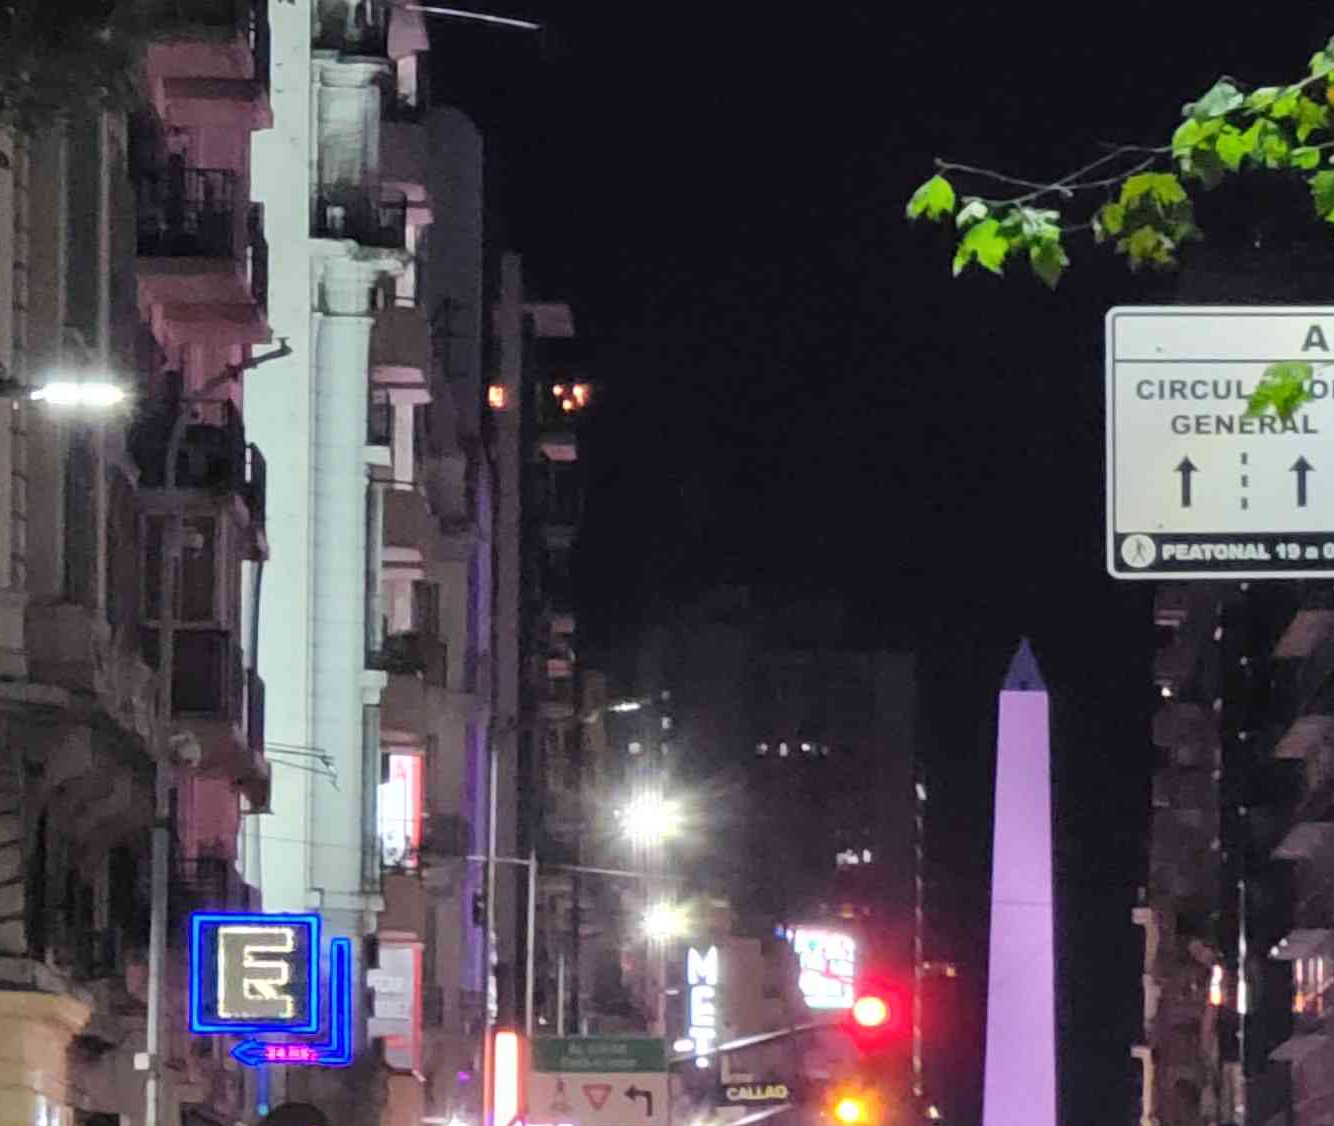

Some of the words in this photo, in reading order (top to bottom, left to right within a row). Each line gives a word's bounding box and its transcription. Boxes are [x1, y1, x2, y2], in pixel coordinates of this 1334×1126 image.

[1301, 324, 1329, 352] A
[1171, 415, 1318, 434] GENERAL
[1162, 544, 1271, 560] PEATONAL
[1276, 543, 1301, 559] 19
[727, 1083, 789, 1101] CALLAO
